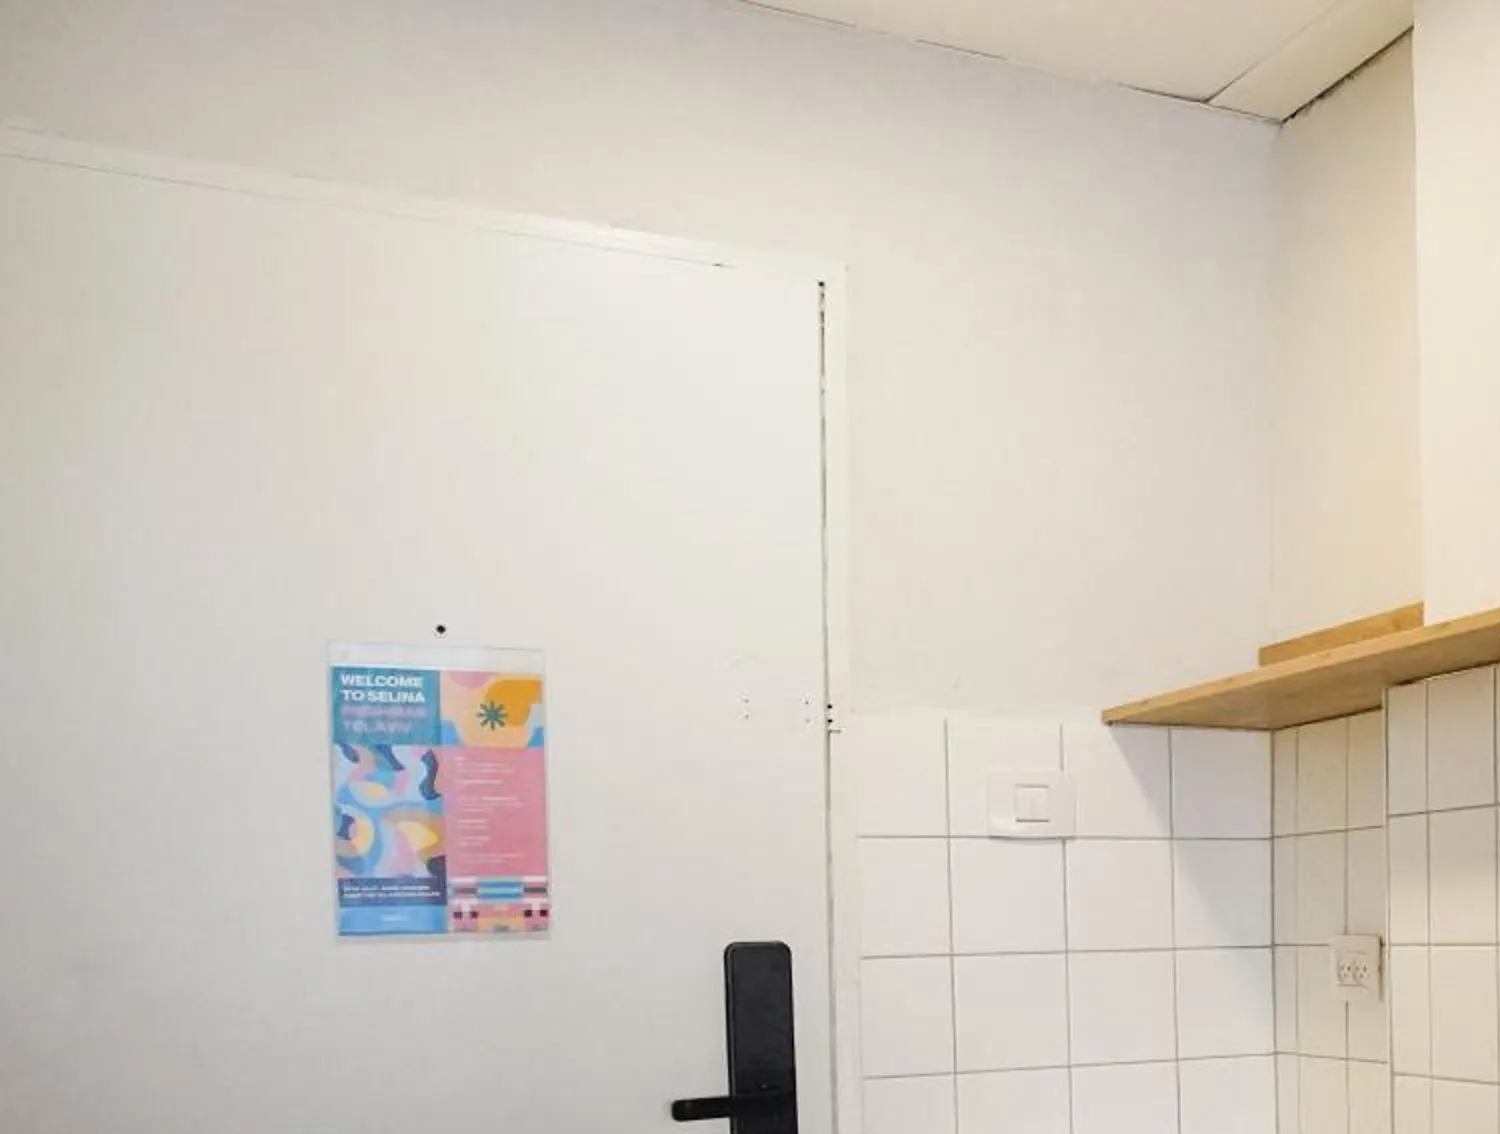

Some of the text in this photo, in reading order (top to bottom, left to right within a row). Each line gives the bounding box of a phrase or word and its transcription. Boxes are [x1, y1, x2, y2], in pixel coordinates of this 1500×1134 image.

[340, 673, 424, 688] WELCOME
[340, 689, 426, 703] TO SELINA
